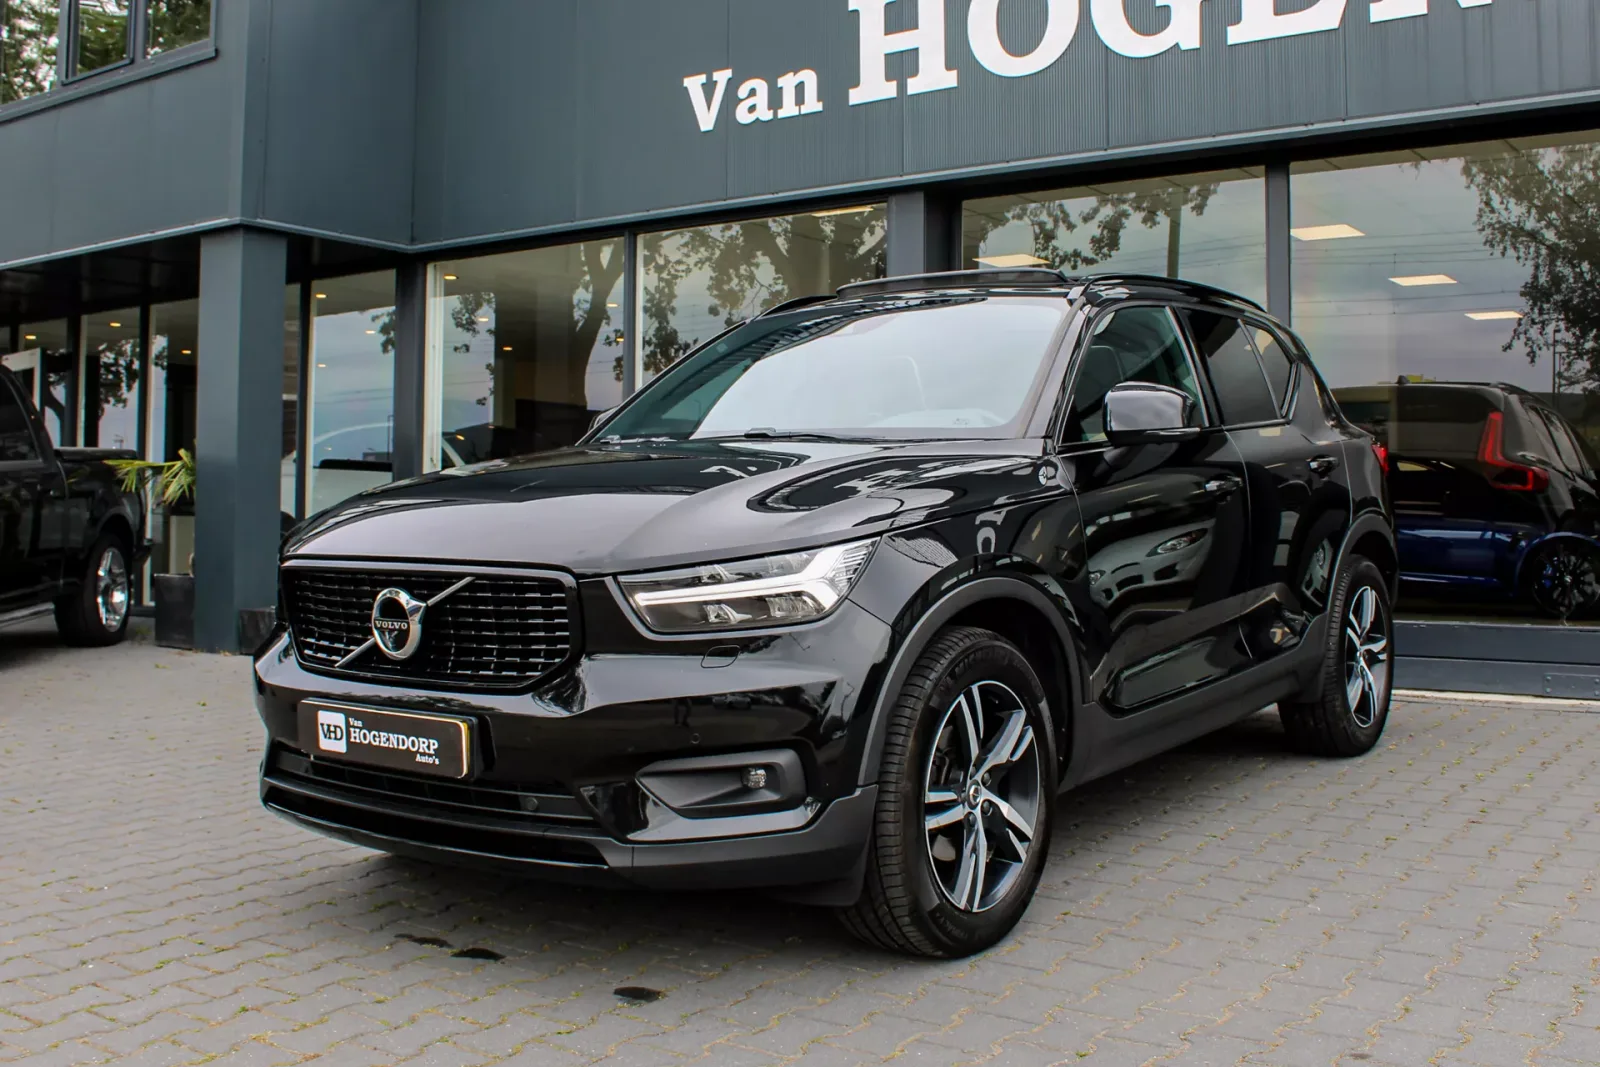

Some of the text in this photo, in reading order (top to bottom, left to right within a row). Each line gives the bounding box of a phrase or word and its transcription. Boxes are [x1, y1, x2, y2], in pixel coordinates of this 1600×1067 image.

[683, 68, 823, 132] Van
[375, 620, 408, 630] VOLVO
[349, 717, 363, 727] Van
[350, 728, 438, 754] HOGENDORP
[415, 753, 440, 765] Auto's
